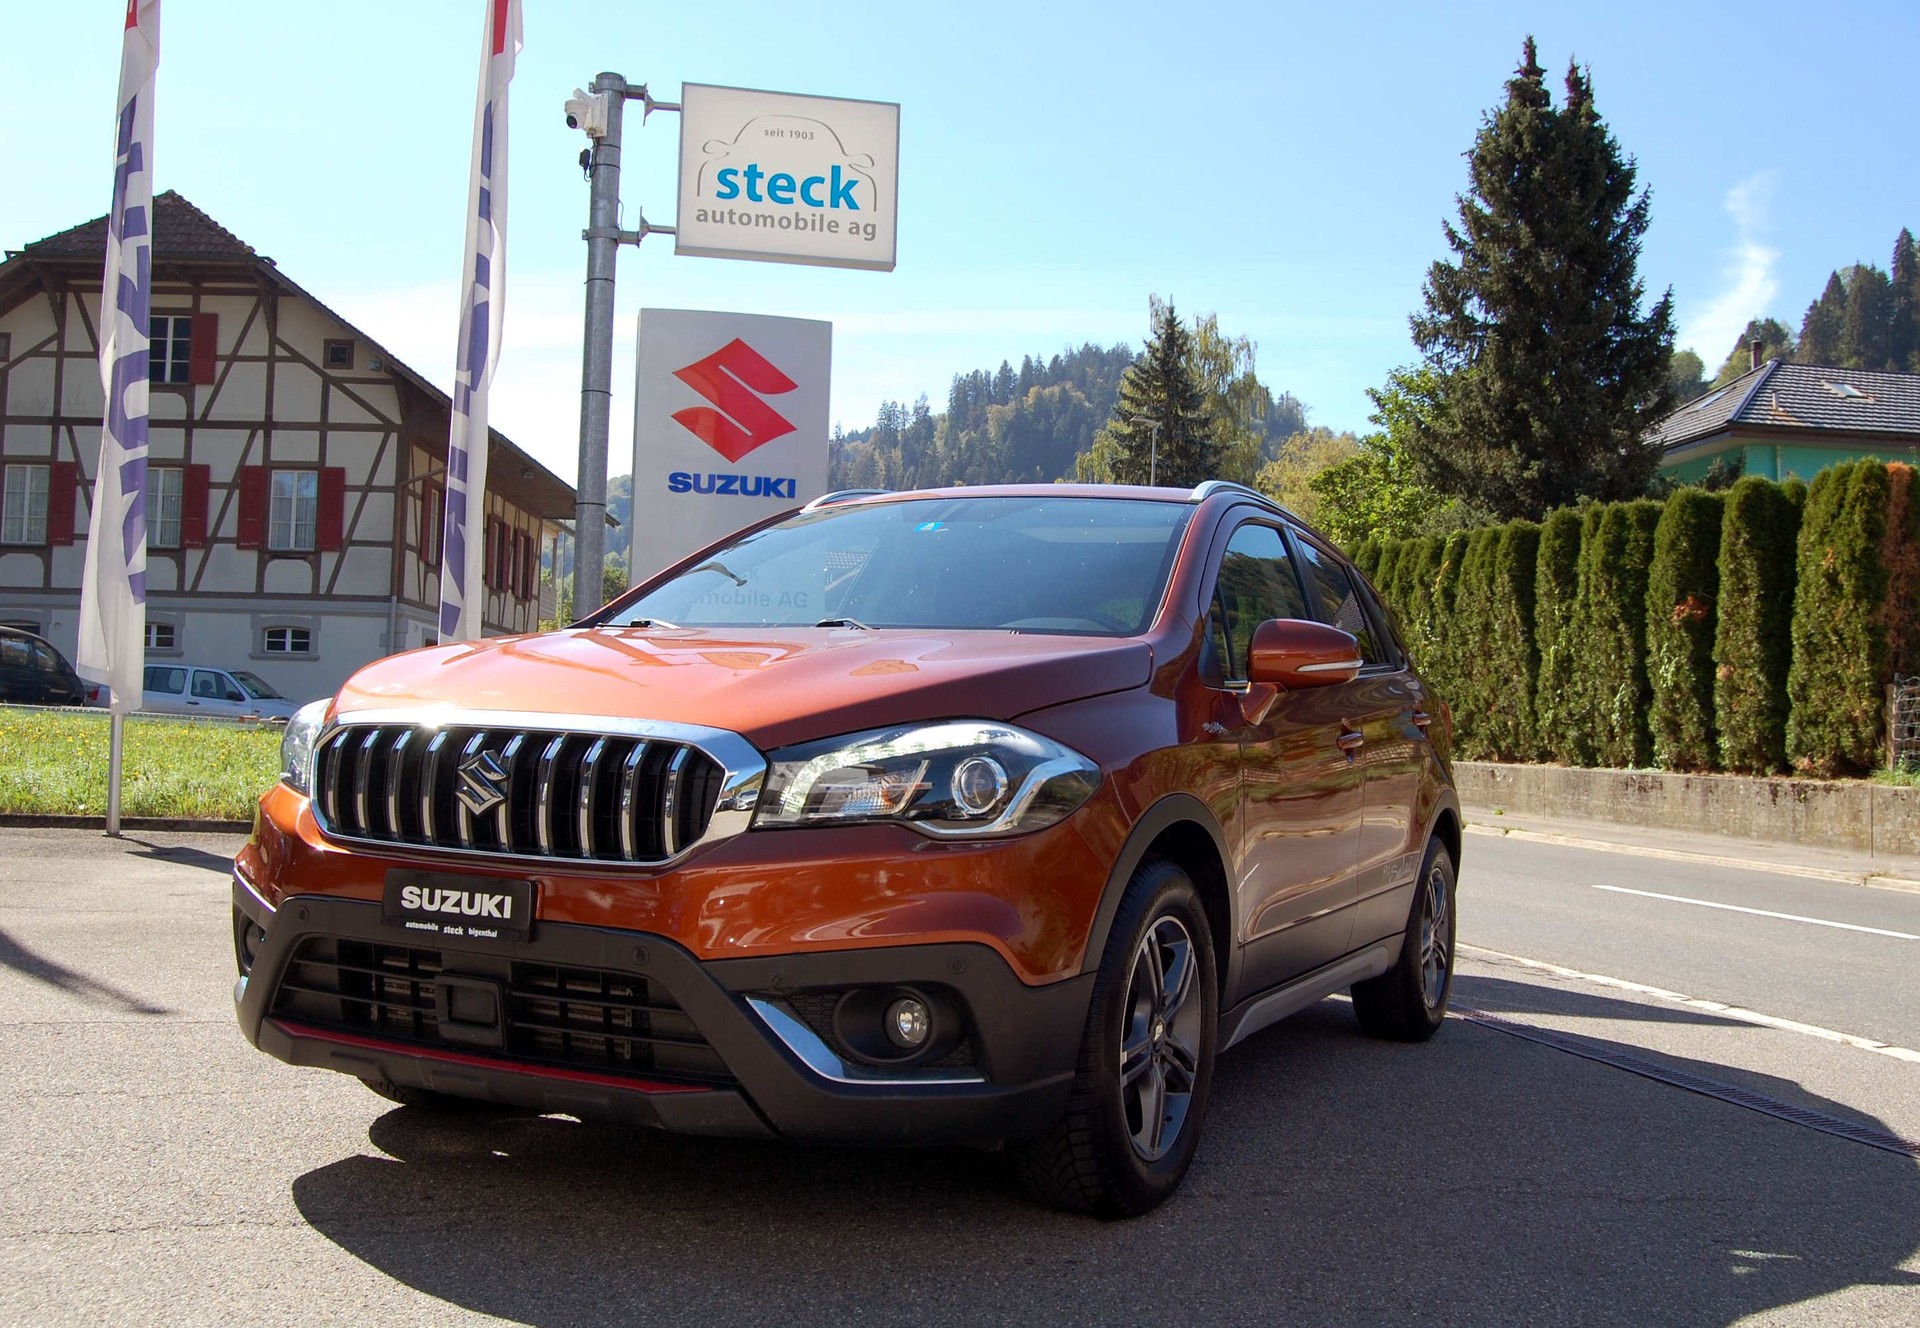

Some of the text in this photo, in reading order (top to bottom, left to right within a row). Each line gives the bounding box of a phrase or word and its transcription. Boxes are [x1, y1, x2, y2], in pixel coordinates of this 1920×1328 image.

[764, 128, 814, 141] seit 1903
[716, 163, 860, 211] steck
[695, 207, 877, 241] automobile ag
[667, 471, 797, 499] SUZUKI
[400, 886, 513, 919] SUZUKI
[405, 921, 439, 931] automobile
[443, 926, 464, 936] steck
